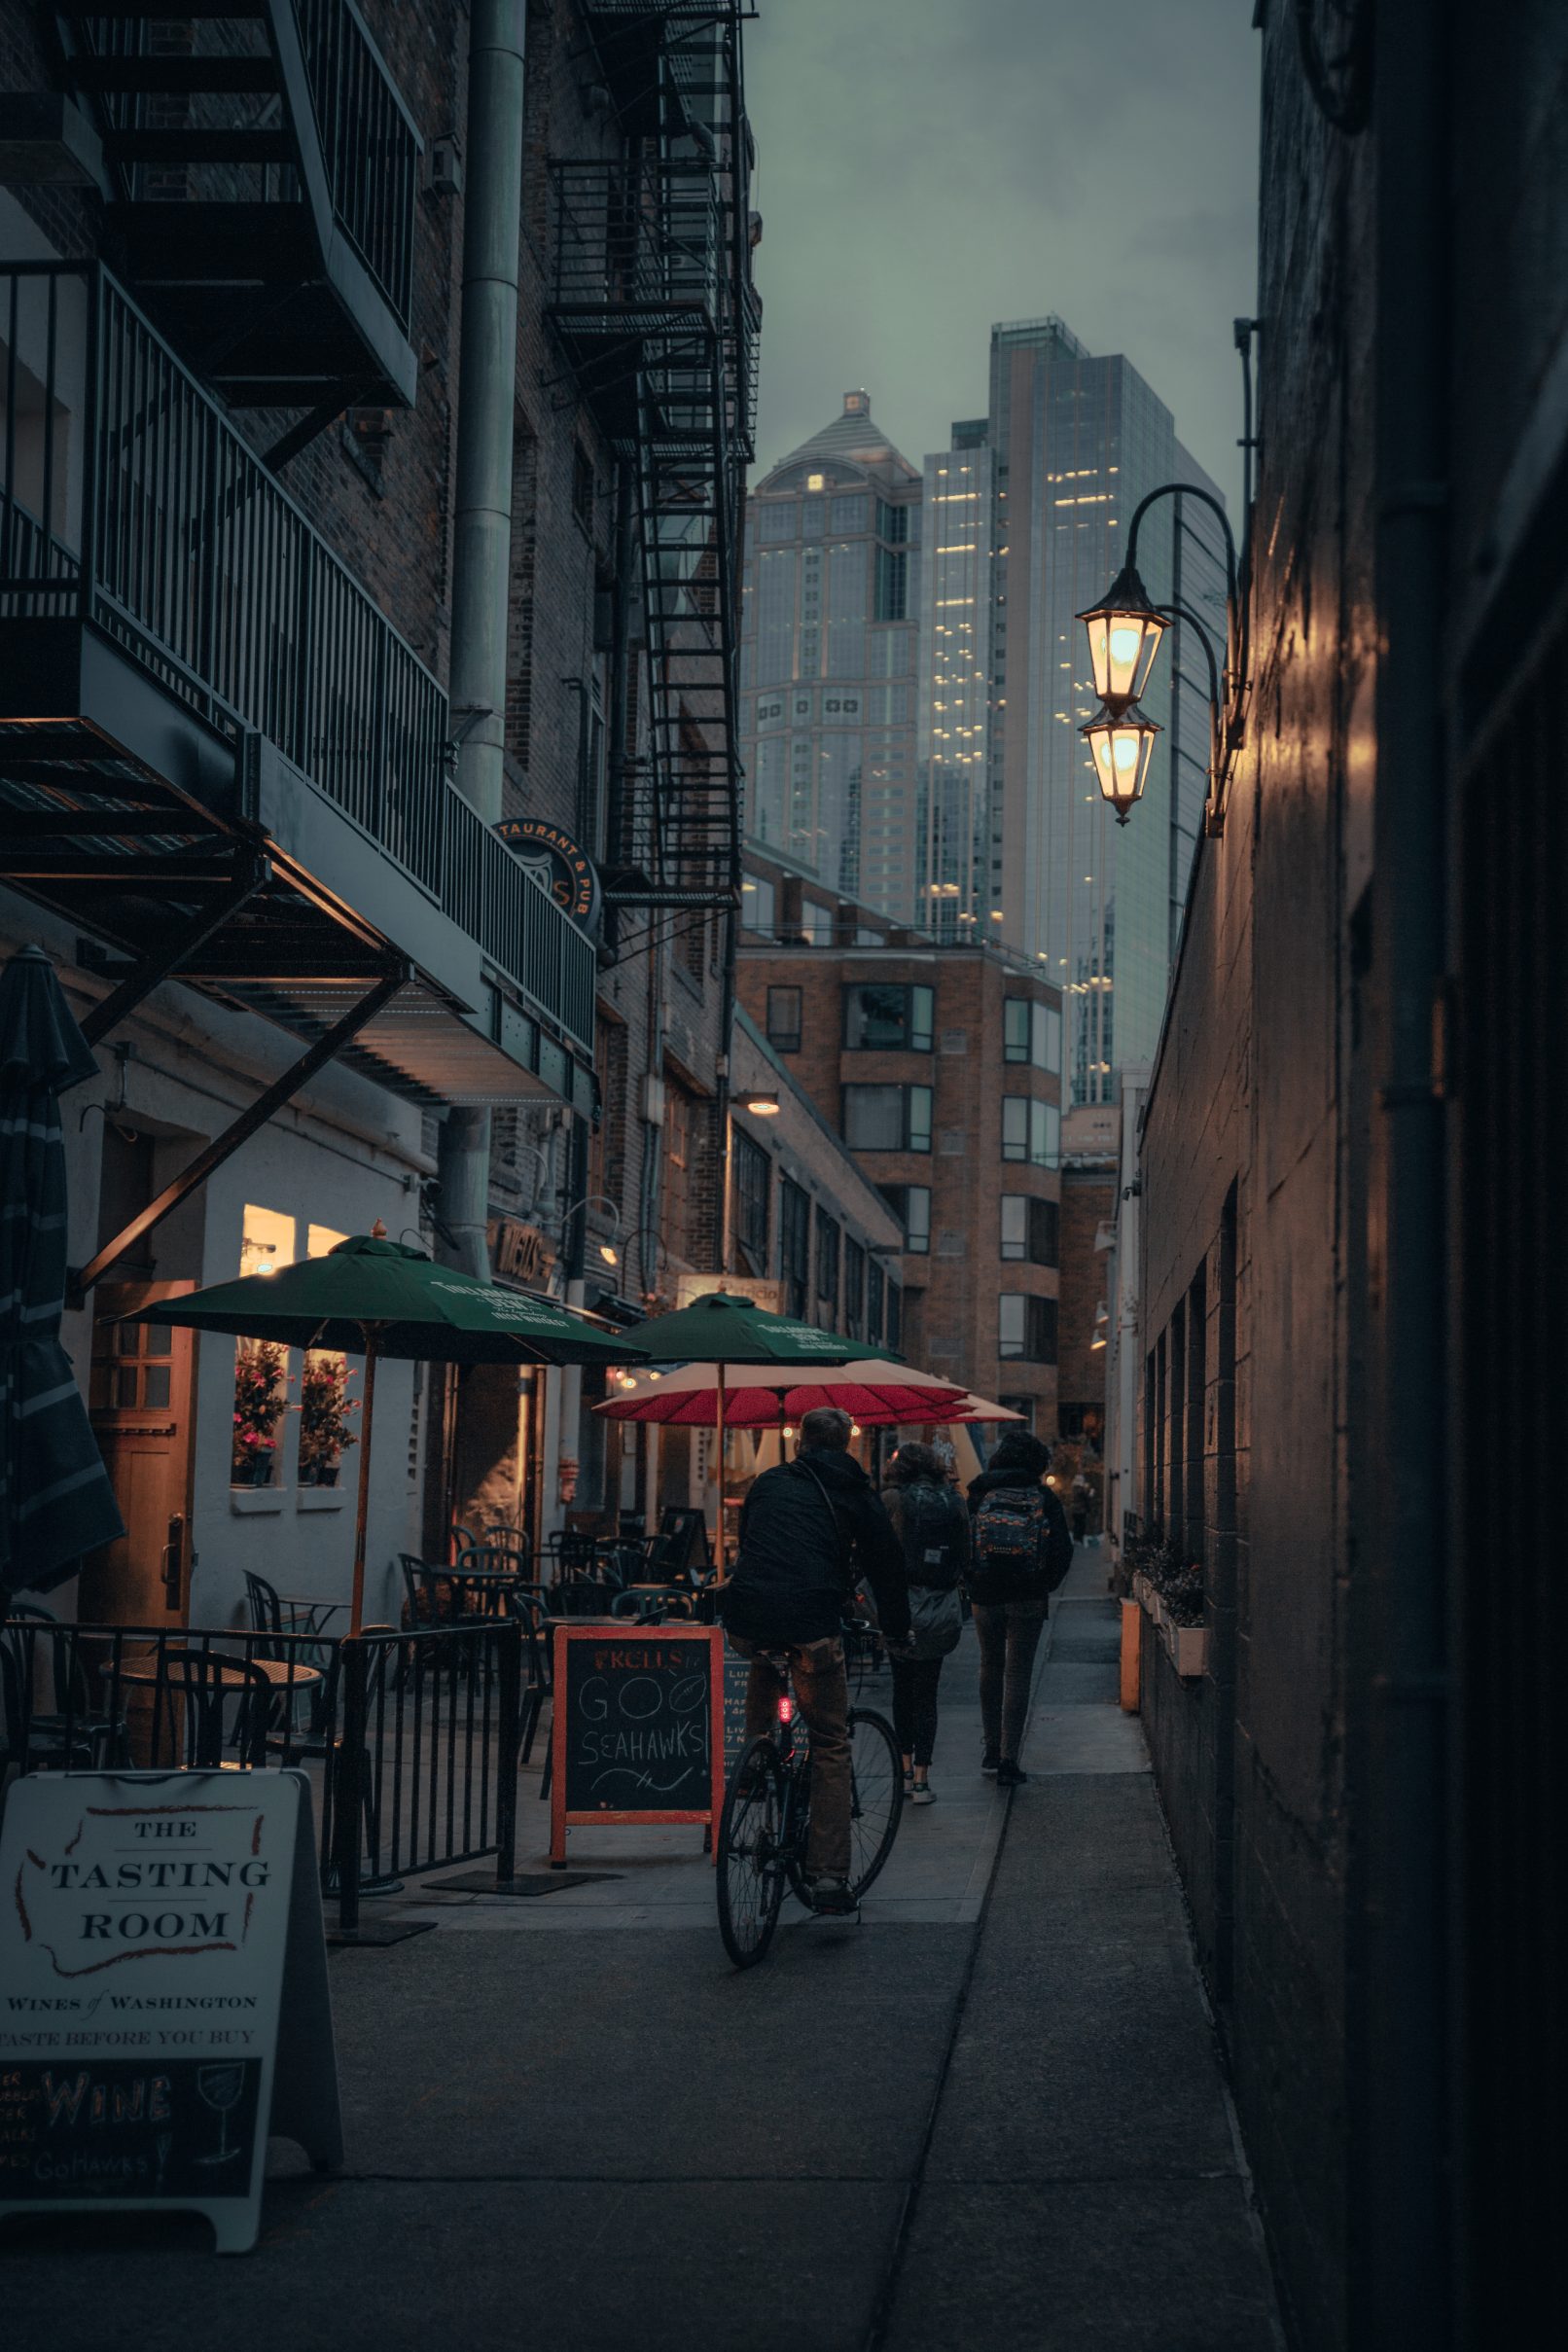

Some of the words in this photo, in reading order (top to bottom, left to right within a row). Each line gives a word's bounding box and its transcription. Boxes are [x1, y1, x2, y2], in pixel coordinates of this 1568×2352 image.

[497, 823, 579, 855] TAURANT
[575, 860, 587, 872] &
[577, 878, 591, 914] PUB
[135, 1822, 197, 1837] THE
[52, 1862, 271, 1889] TASTING
[78, 1912, 229, 1940] ROOM
[8, 1997, 81, 2012] WINES
[81, 1989, 109, 2021] of
[111, 1996, 258, 2010] WASHINGTON
[65, 2031, 150, 2047] BEFORE
[160, 2029, 202, 2045] YOU
[209, 2029, 255, 2045] BUY
